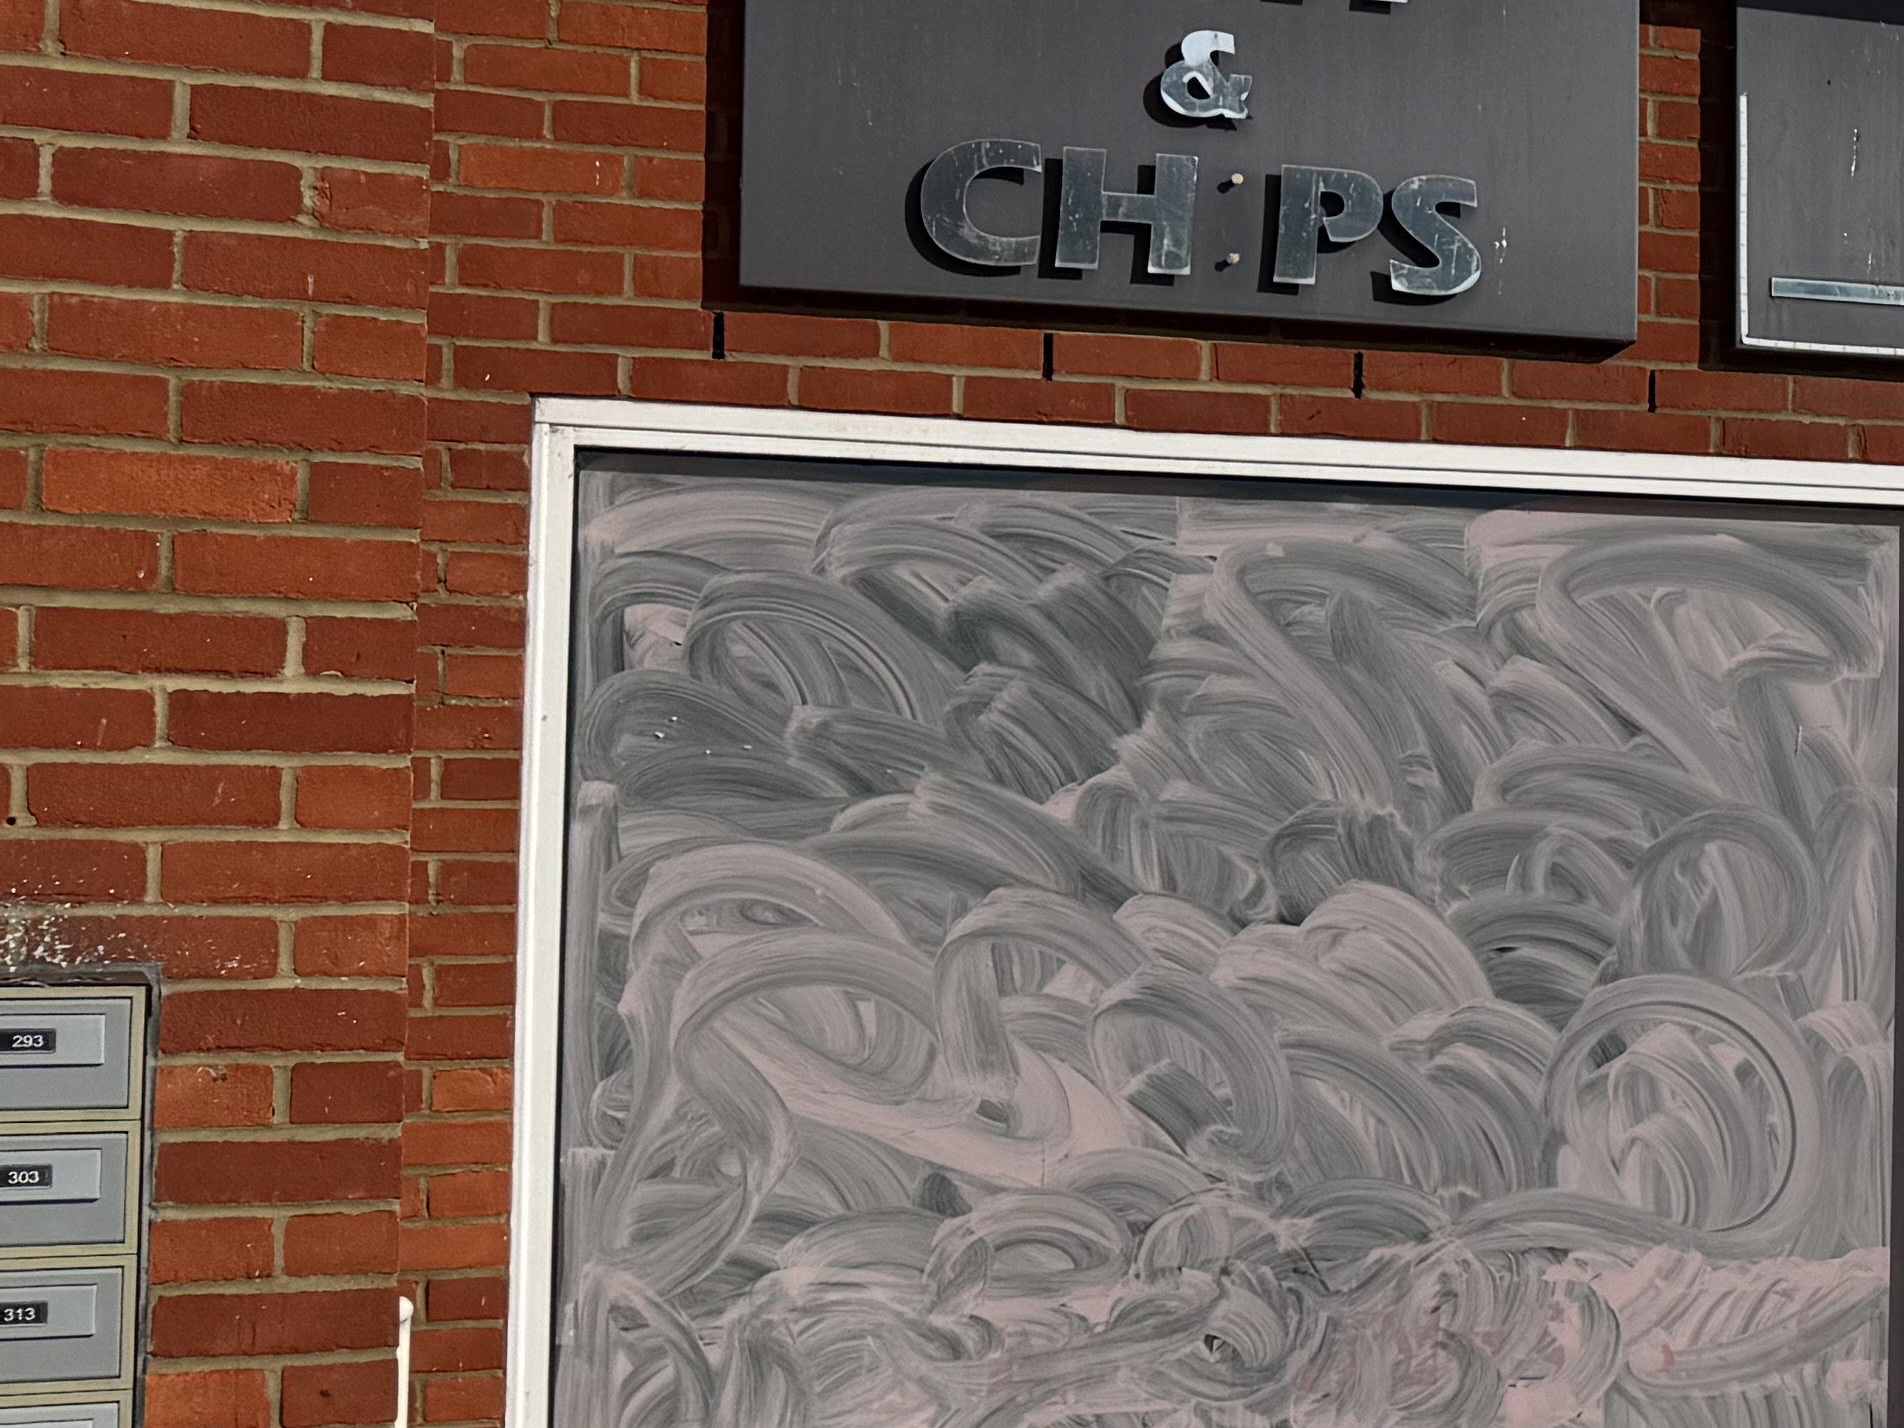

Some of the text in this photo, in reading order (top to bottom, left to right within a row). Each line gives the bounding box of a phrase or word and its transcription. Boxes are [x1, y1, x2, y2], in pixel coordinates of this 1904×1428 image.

[1160, 29, 1253, 120] &
[919, 137, 1483, 296] CHPS
[11, 1033, 45, 1049] 293
[7, 1170, 40, 1185] 303
[3, 1307, 36, 1322] 313
